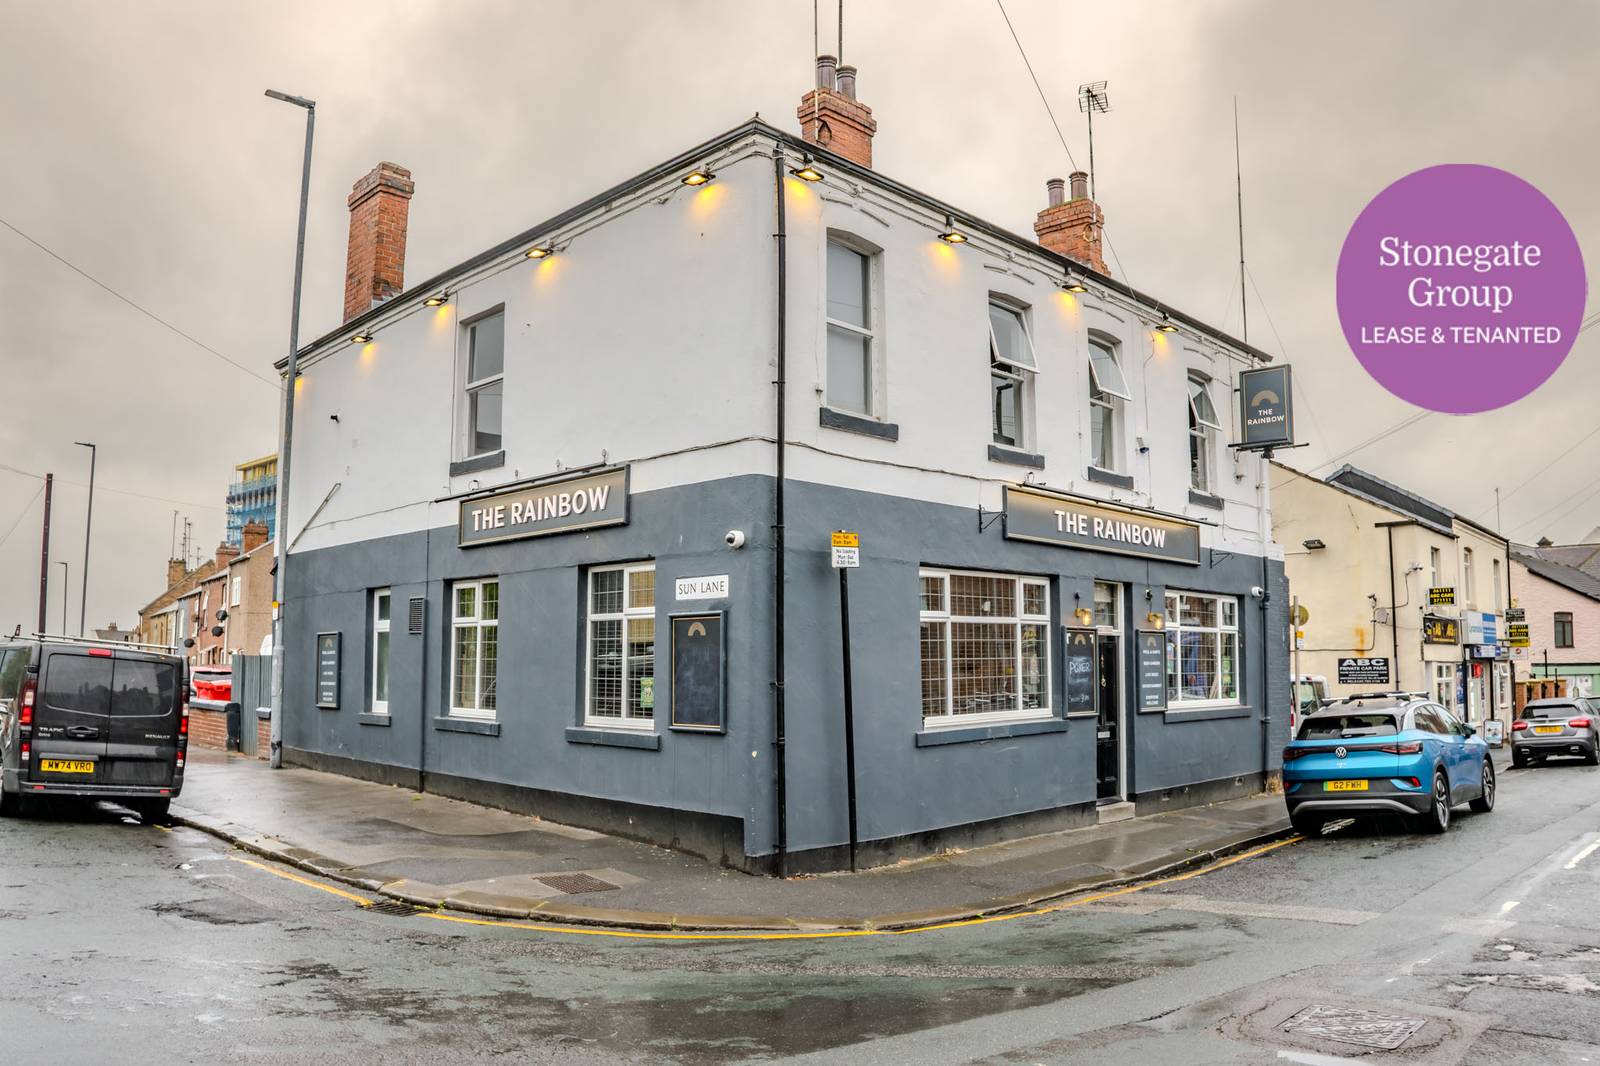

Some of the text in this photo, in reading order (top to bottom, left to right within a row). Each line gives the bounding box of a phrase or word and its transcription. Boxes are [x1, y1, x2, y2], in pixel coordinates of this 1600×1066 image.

[1258, 408, 1273, 416] THE
[1247, 415, 1285, 426] RAINBOW
[472, 485, 610, 532] THE RAINBOW
[1054, 509, 1166, 548] THE RAINBOW
[678, 581, 725, 595] SUN LANE
[1342, 659, 1385, 667] ABC
[1333, 781, 1344, 790] G2
